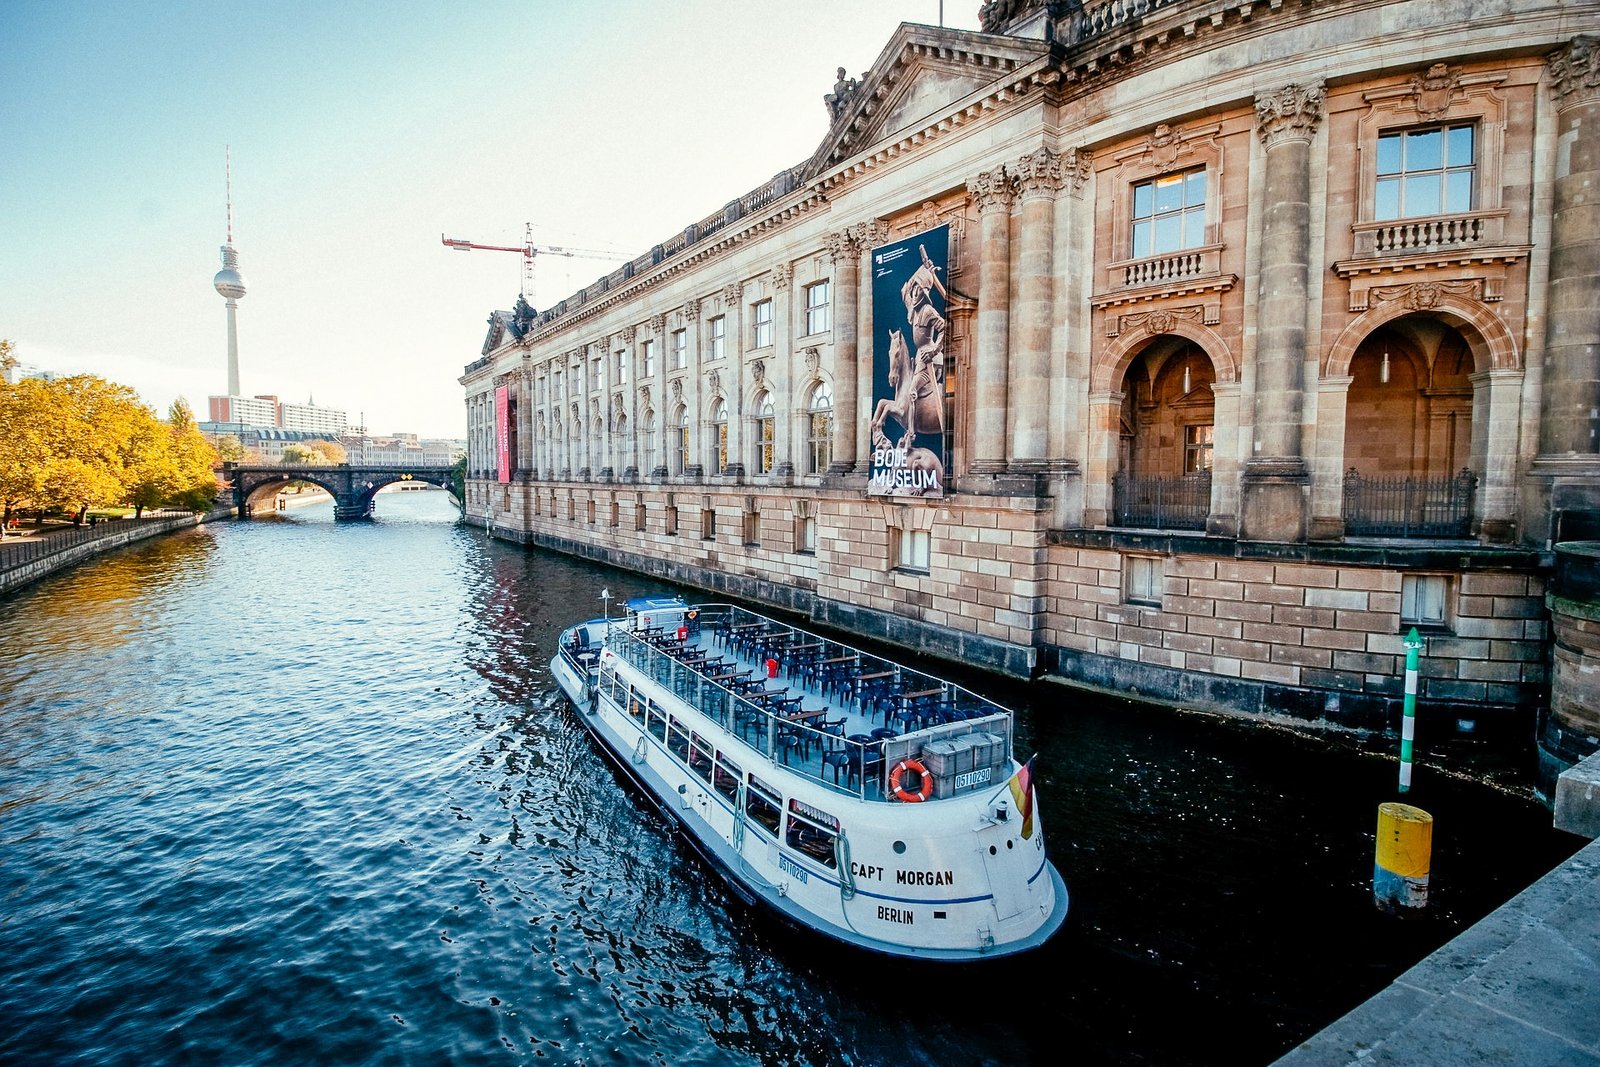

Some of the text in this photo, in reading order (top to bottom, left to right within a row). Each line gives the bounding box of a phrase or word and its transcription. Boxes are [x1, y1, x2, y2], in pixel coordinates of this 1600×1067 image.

[874, 448, 908, 467] BODE
[872, 469, 938, 489] MUSEUM
[956, 768, 990, 788] 05110290
[778, 857, 808, 885] 05110290
[851, 862, 954, 886] CAPT MORGAN
[877, 905, 914, 925] BERLIN
